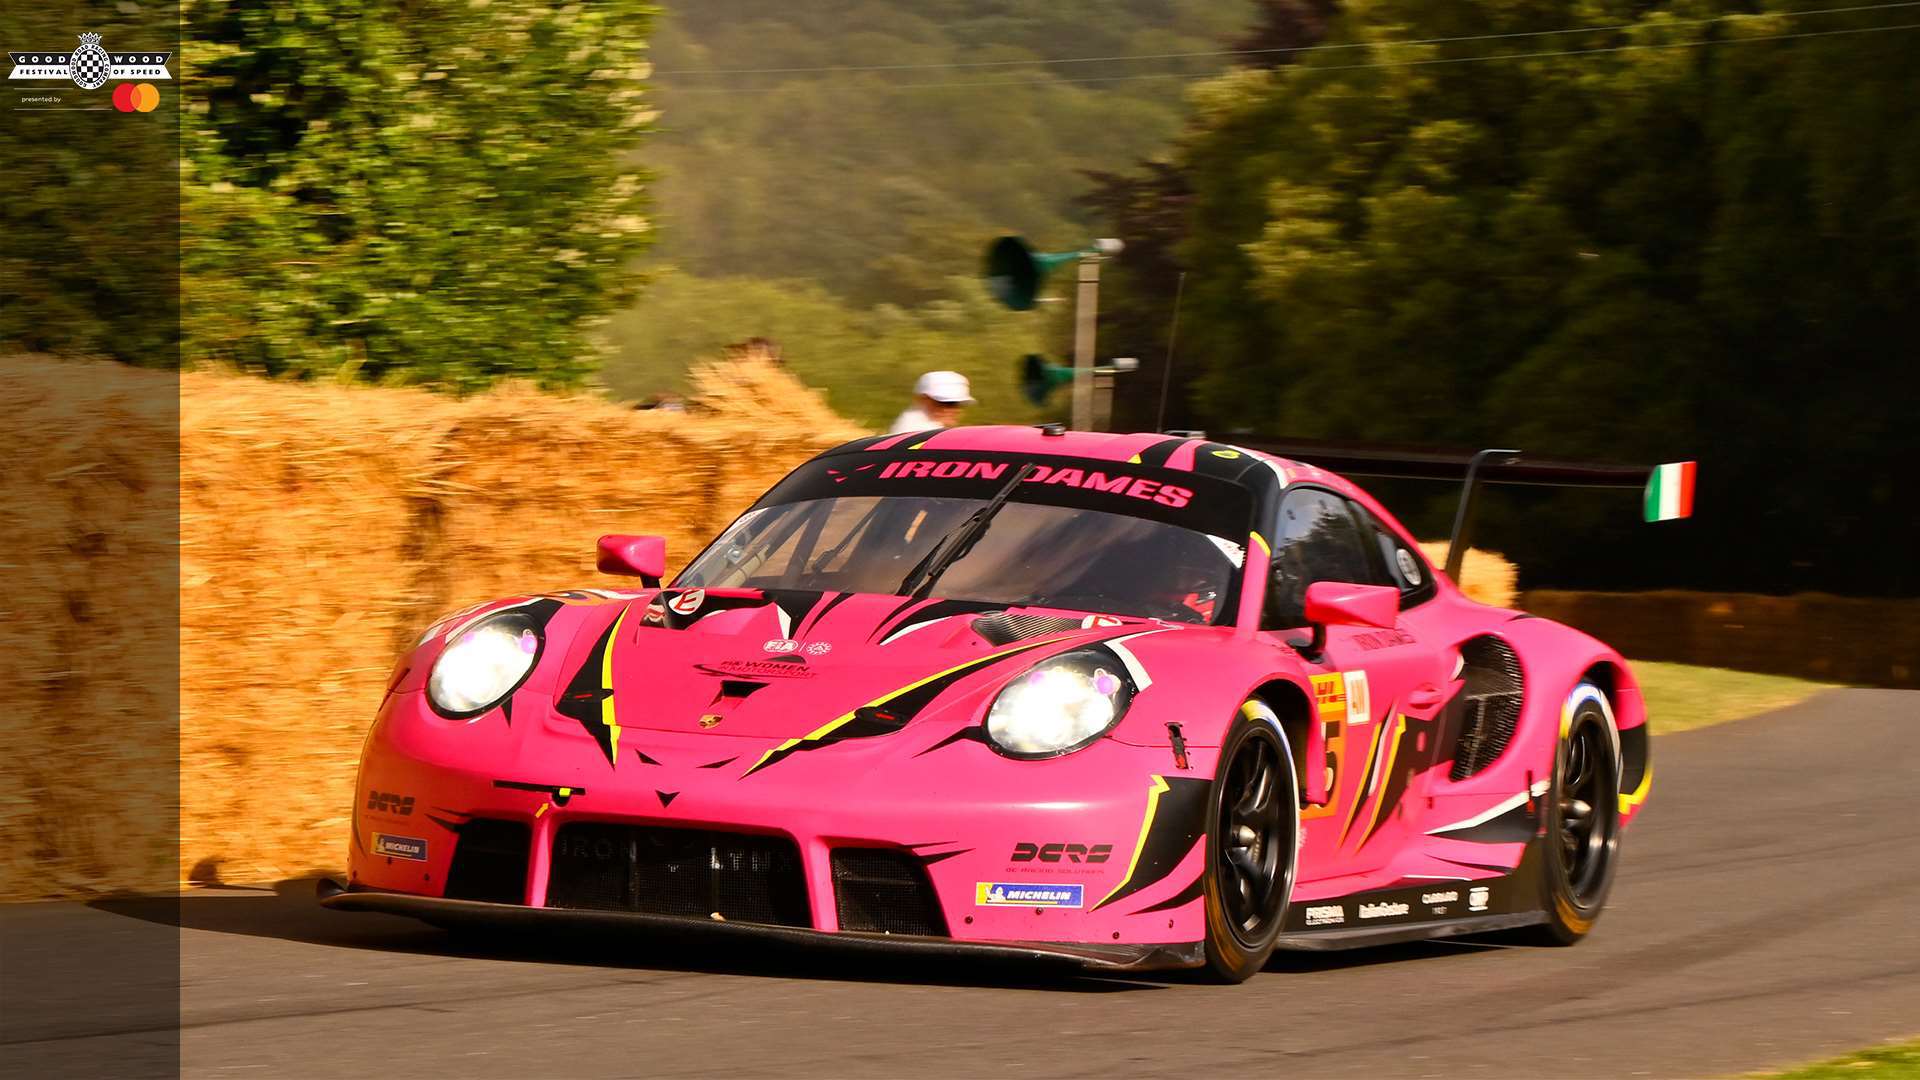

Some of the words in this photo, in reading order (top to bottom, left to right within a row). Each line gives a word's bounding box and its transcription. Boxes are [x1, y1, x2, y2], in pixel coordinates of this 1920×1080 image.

[878, 461, 1009, 480] IRON
[1022, 463, 1195, 509] DAMES
[745, 661, 811, 672] WOMEN
[1006, 889, 1072, 901] MICHELIN
